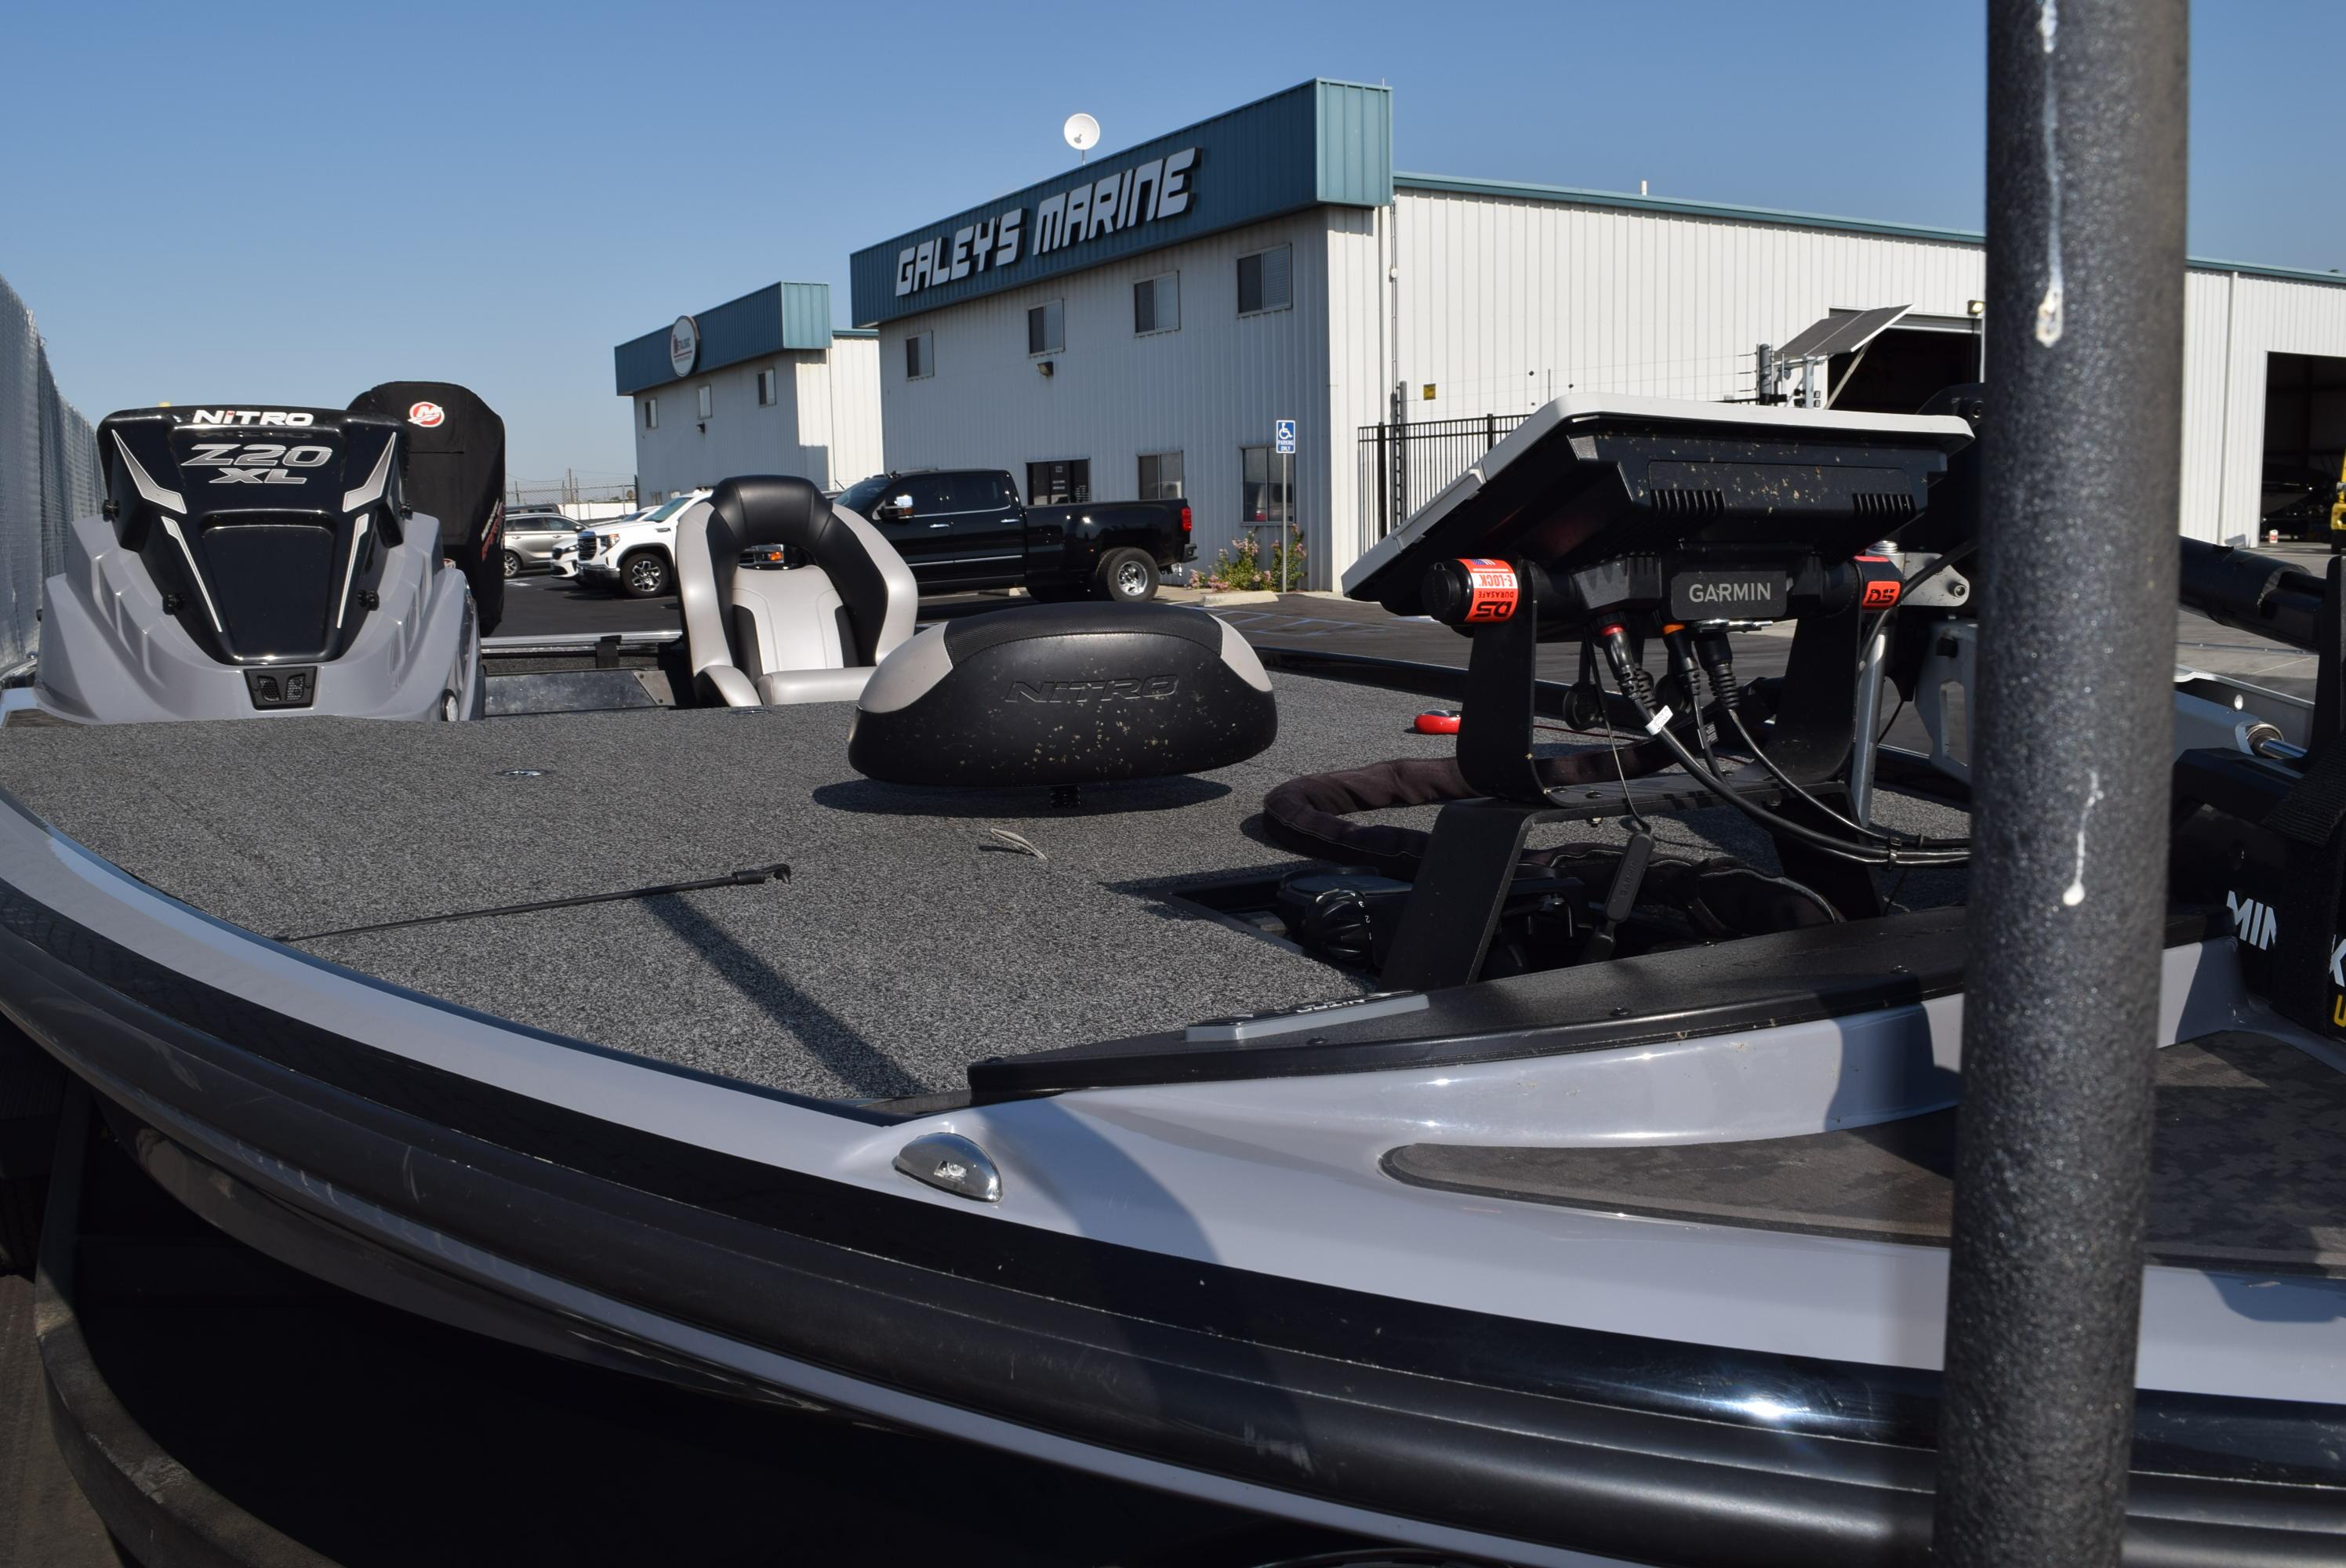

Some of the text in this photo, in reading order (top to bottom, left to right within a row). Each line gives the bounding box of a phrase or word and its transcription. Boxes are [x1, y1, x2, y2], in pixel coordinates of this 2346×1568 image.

[895, 147, 1198, 296] GALEY'S MARINE
[180, 444, 333, 467] Z20
[209, 468, 307, 484] XL
[1689, 583, 1770, 602] GARMIN
[1866, 589, 1896, 603] DS
[1473, 601, 1513, 617] DS
[1004, 674, 1178, 702] NITRO
